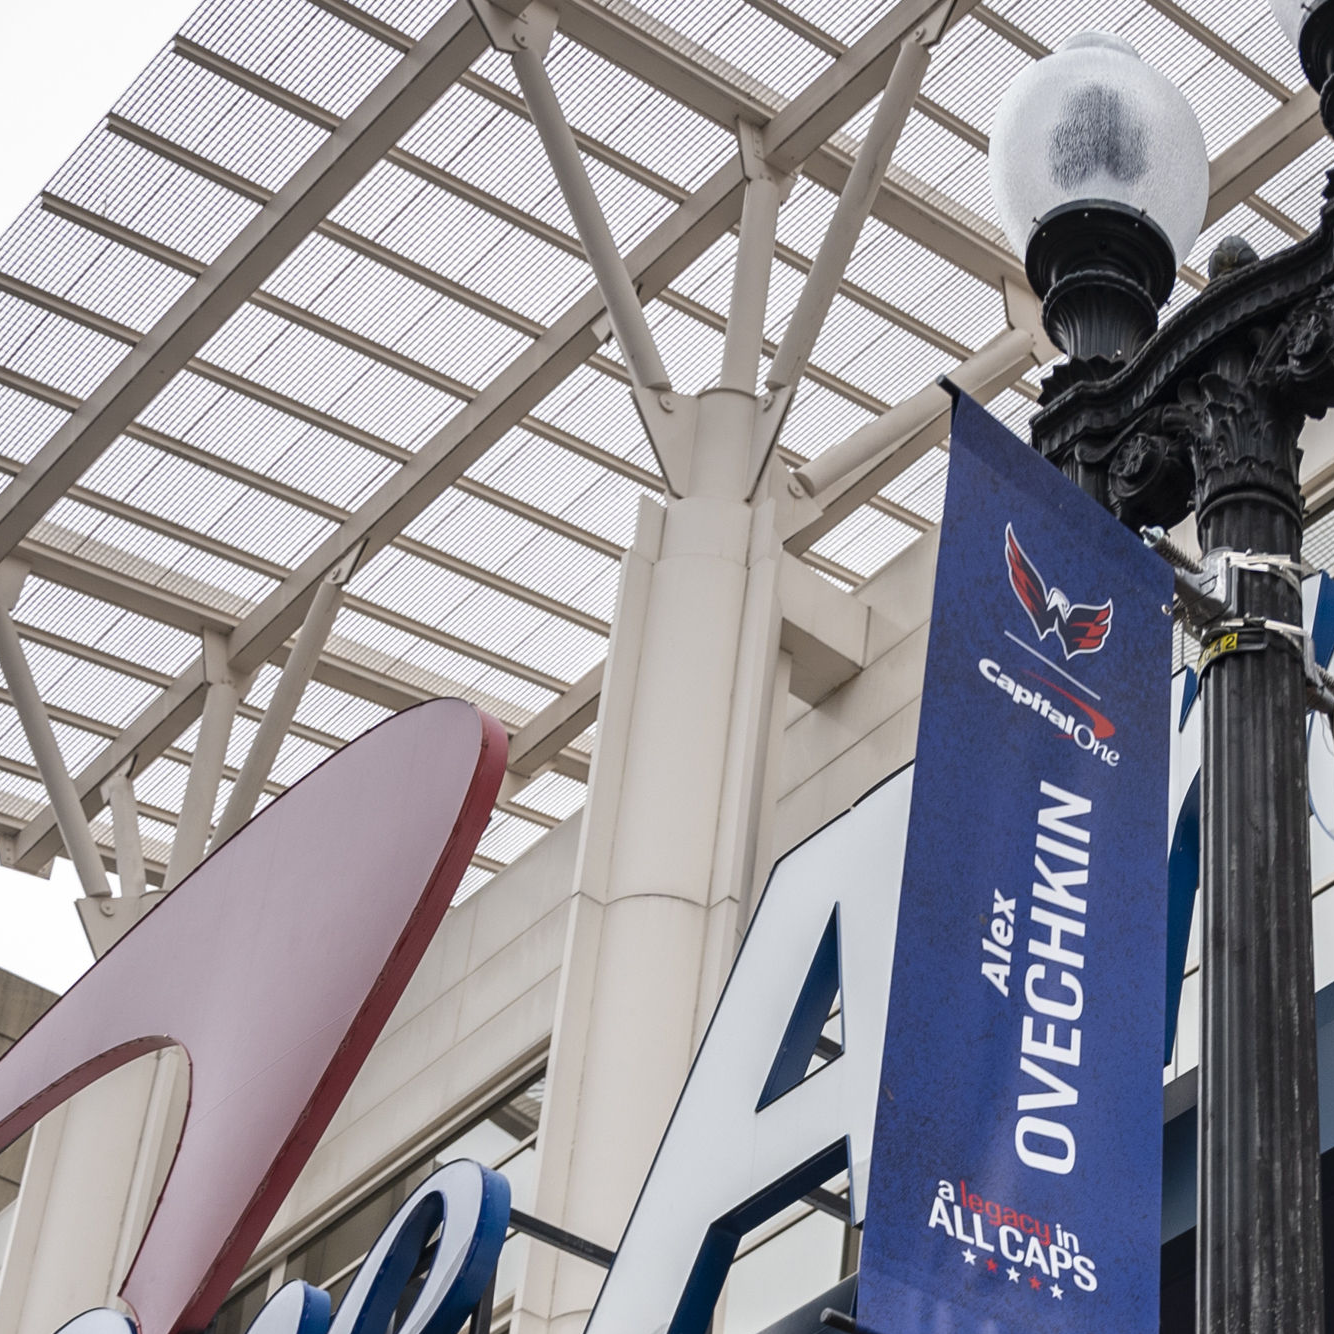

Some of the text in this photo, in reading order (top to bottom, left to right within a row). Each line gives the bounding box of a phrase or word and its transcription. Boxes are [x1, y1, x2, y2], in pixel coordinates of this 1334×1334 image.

[981, 888, 1016, 998] Alex
[1014, 779, 1092, 1175] OVECHKIN
[928, 1196, 1098, 1292] ALL CAPS
[937, 1179, 1080, 1254] a legacy in
